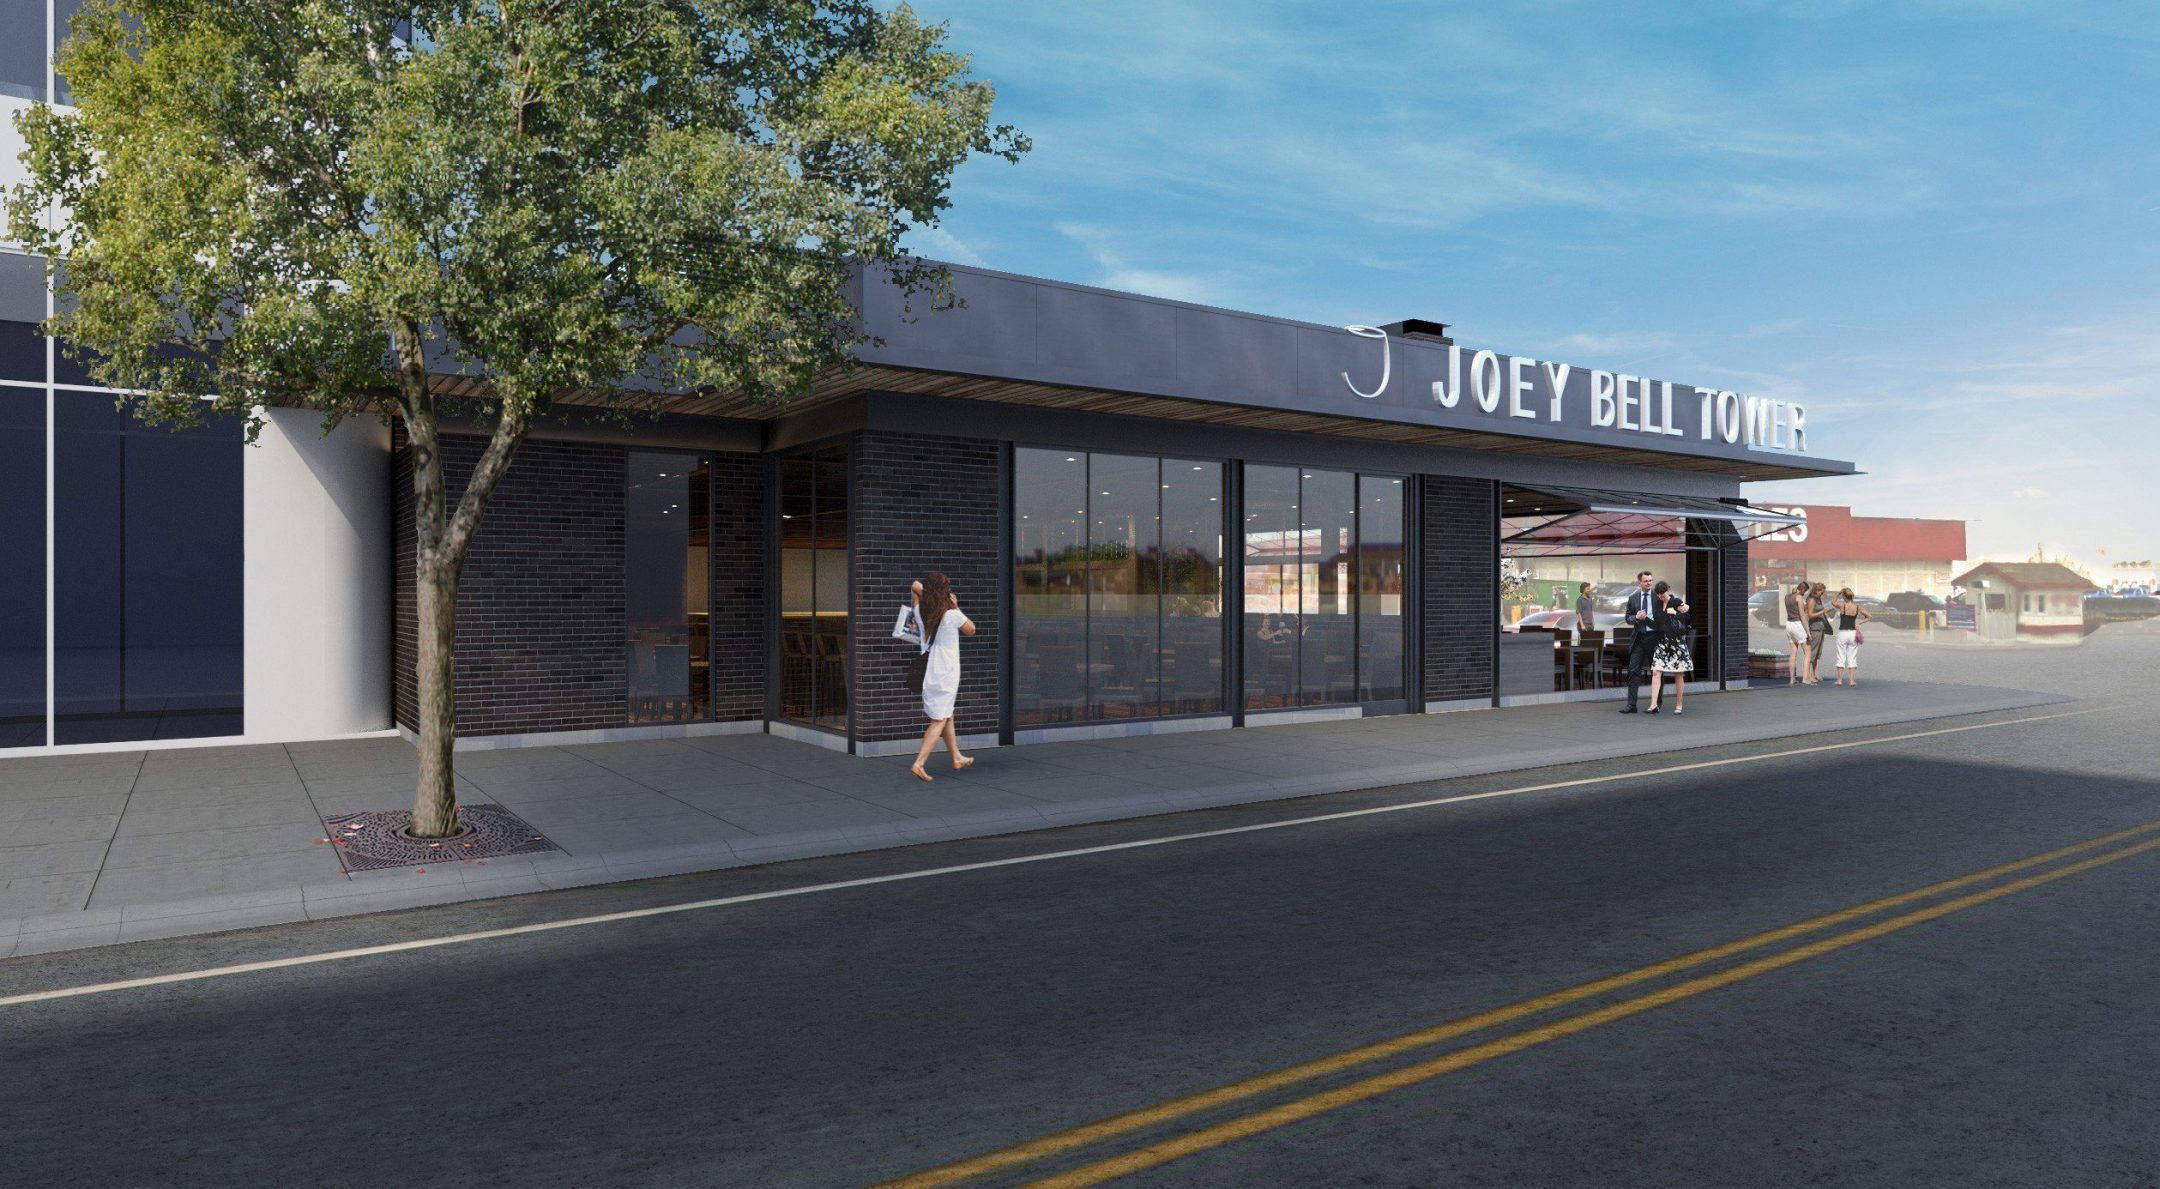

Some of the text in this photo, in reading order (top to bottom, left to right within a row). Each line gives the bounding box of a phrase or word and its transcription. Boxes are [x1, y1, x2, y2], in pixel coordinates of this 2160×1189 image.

[1432, 345, 1571, 422] JOEY
[1591, 369, 1684, 437] BELL
[1694, 387, 1807, 452] TOWER
